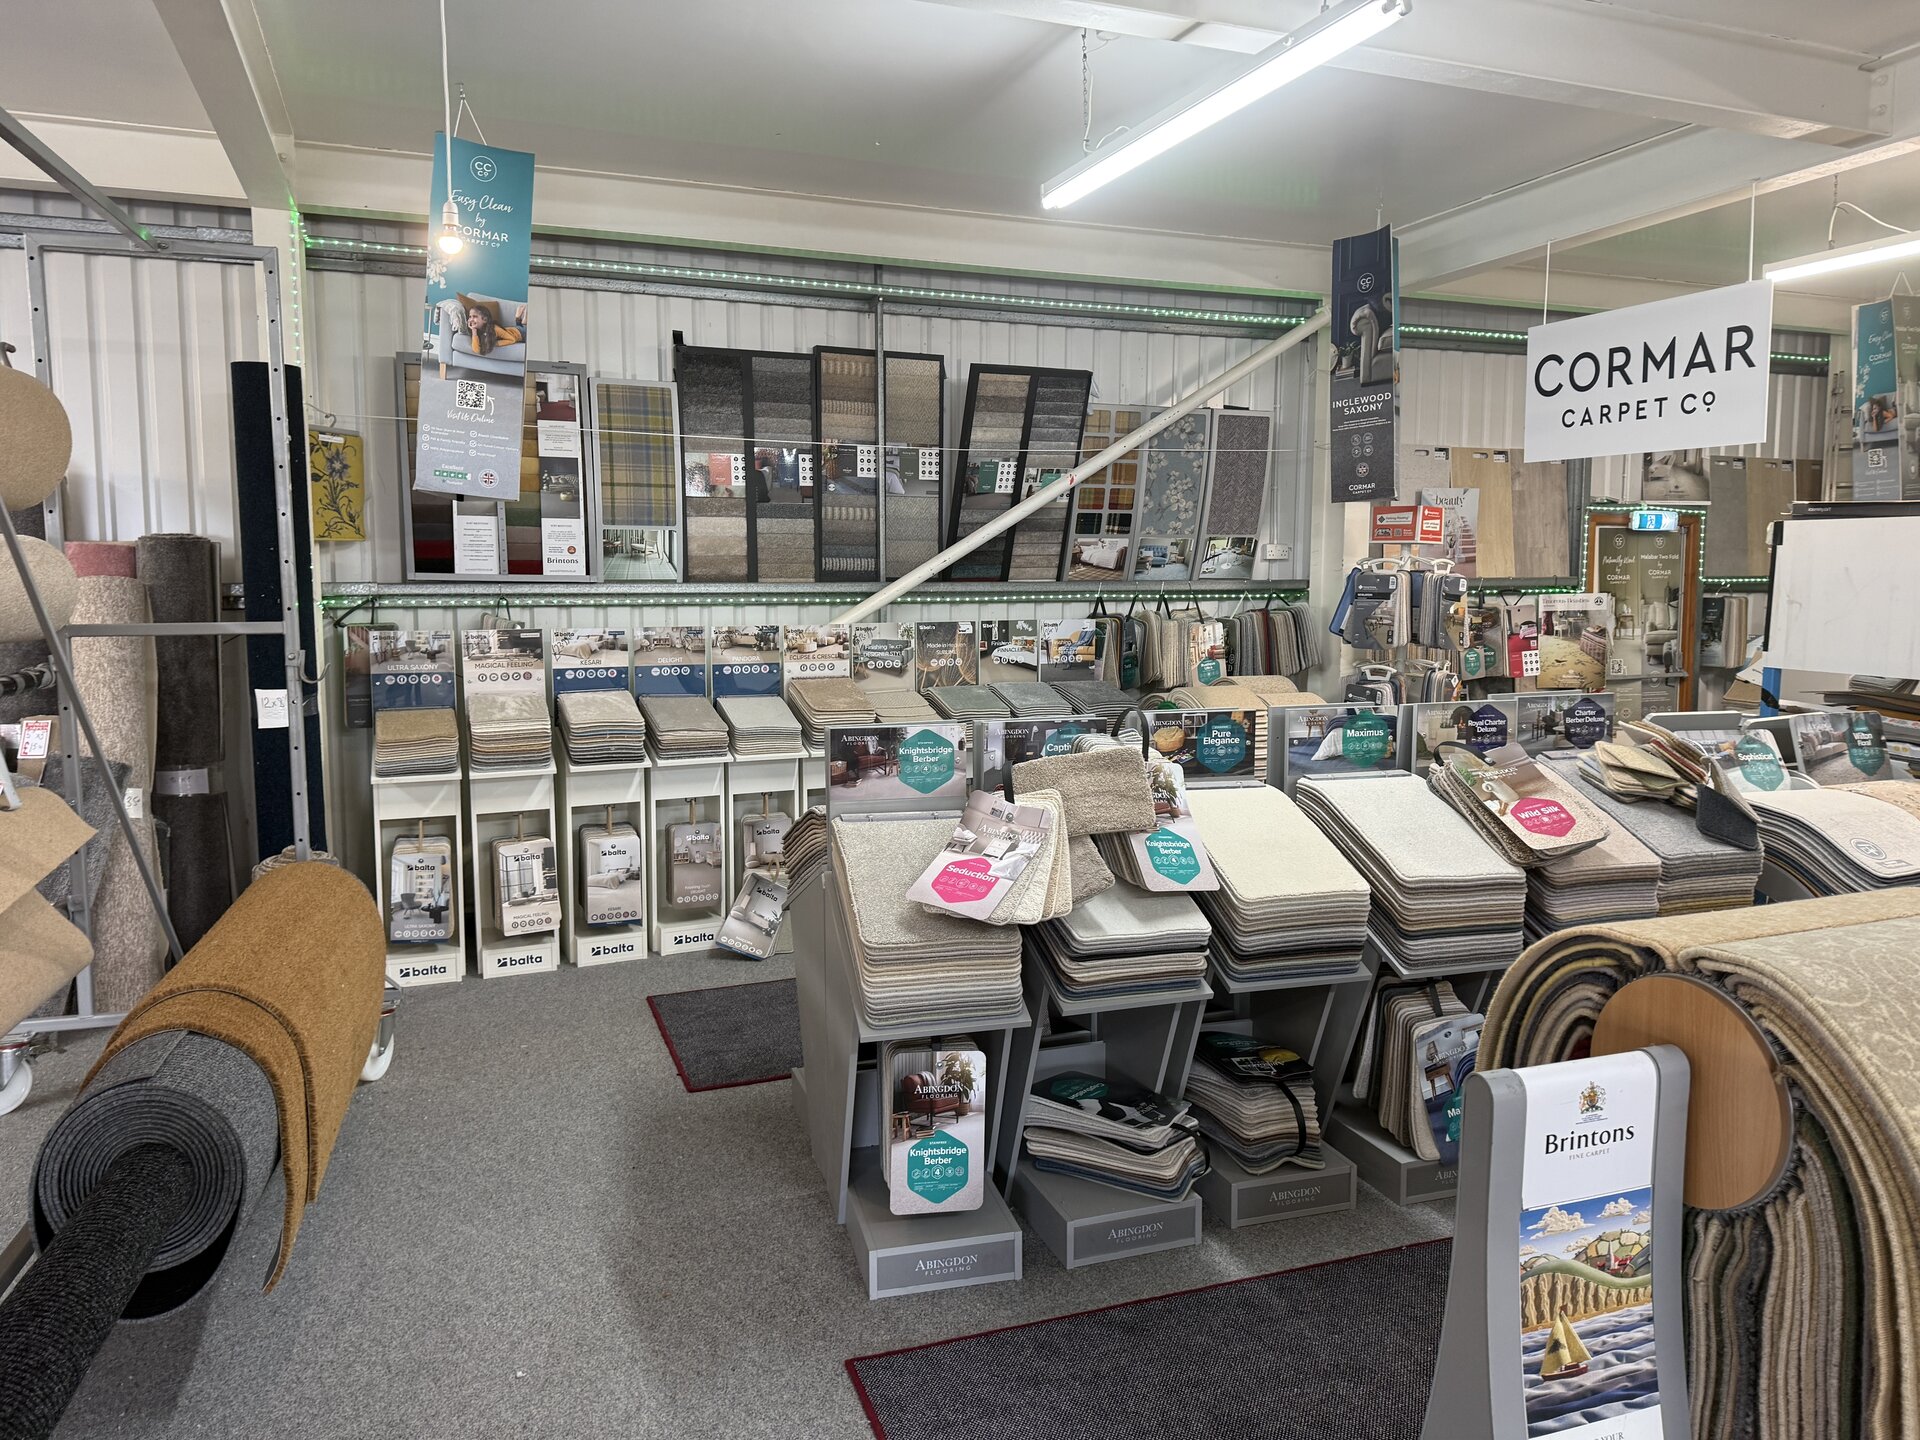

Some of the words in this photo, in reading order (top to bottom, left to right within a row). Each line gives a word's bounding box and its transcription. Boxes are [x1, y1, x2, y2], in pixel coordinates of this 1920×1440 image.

[450, 189, 478, 212] Easy
[480, 194, 514, 214] Clean
[475, 212, 487, 228] by
[1534, 324, 1756, 398] CORMAR
[1332, 392, 1392, 408] INGLEWOOD
[1344, 402, 1384, 416] SAXONY
[1561, 396, 1668, 428] CARPET
[470, 413, 496, 424] Online
[1348, 482, 1376, 491] CORMAR
[1436, 493, 1464, 508] beauty
[1346, 729, 1384, 738] Maximus
[1047, 742, 1071, 752] Captiv
[1203, 737, 1240, 746] Elegance
[899, 746, 953, 756] Knightsbridge
[1738, 753, 1775, 761] Sophisticat
[1479, 766, 1518, 778] ABINGDON
[1517, 810, 1541, 819] Wild
[1541, 806, 1560, 815] Silk
[979, 824, 1022, 840] ABINGDON
[1146, 840, 1190, 849] Knightsbridge
[521, 854, 540, 862] balta
[946, 865, 996, 883] Seduction
[762, 889, 778, 902] balta
[685, 933, 714, 944] balta
[603, 944, 634, 955] balta
[509, 954, 543, 967] balta
[412, 965, 447, 977] balta
[1432, 1045, 1470, 1063] ABINGDON
[914, 1080, 963, 1094] ABINGDON
[1545, 1125, 1635, 1155] Brintons
[910, 1147, 967, 1158] Knightsbridge
[1569, 1152, 1584, 1160] FINE
[1586, 1148, 1610, 1158] CARPET
[924, 1157, 952, 1165] Berber
[1434, 1170, 1458, 1181] ABIN
[1269, 1186, 1321, 1202] ABINGDON
[1276, 1196, 1314, 1207] FLOORING
[1107, 1222, 1164, 1241] ABINGDON
[1116, 1232, 1158, 1244] FLOORING
[915, 1254, 978, 1271] ABINGDON
[925, 1265, 972, 1276] FLOORING
